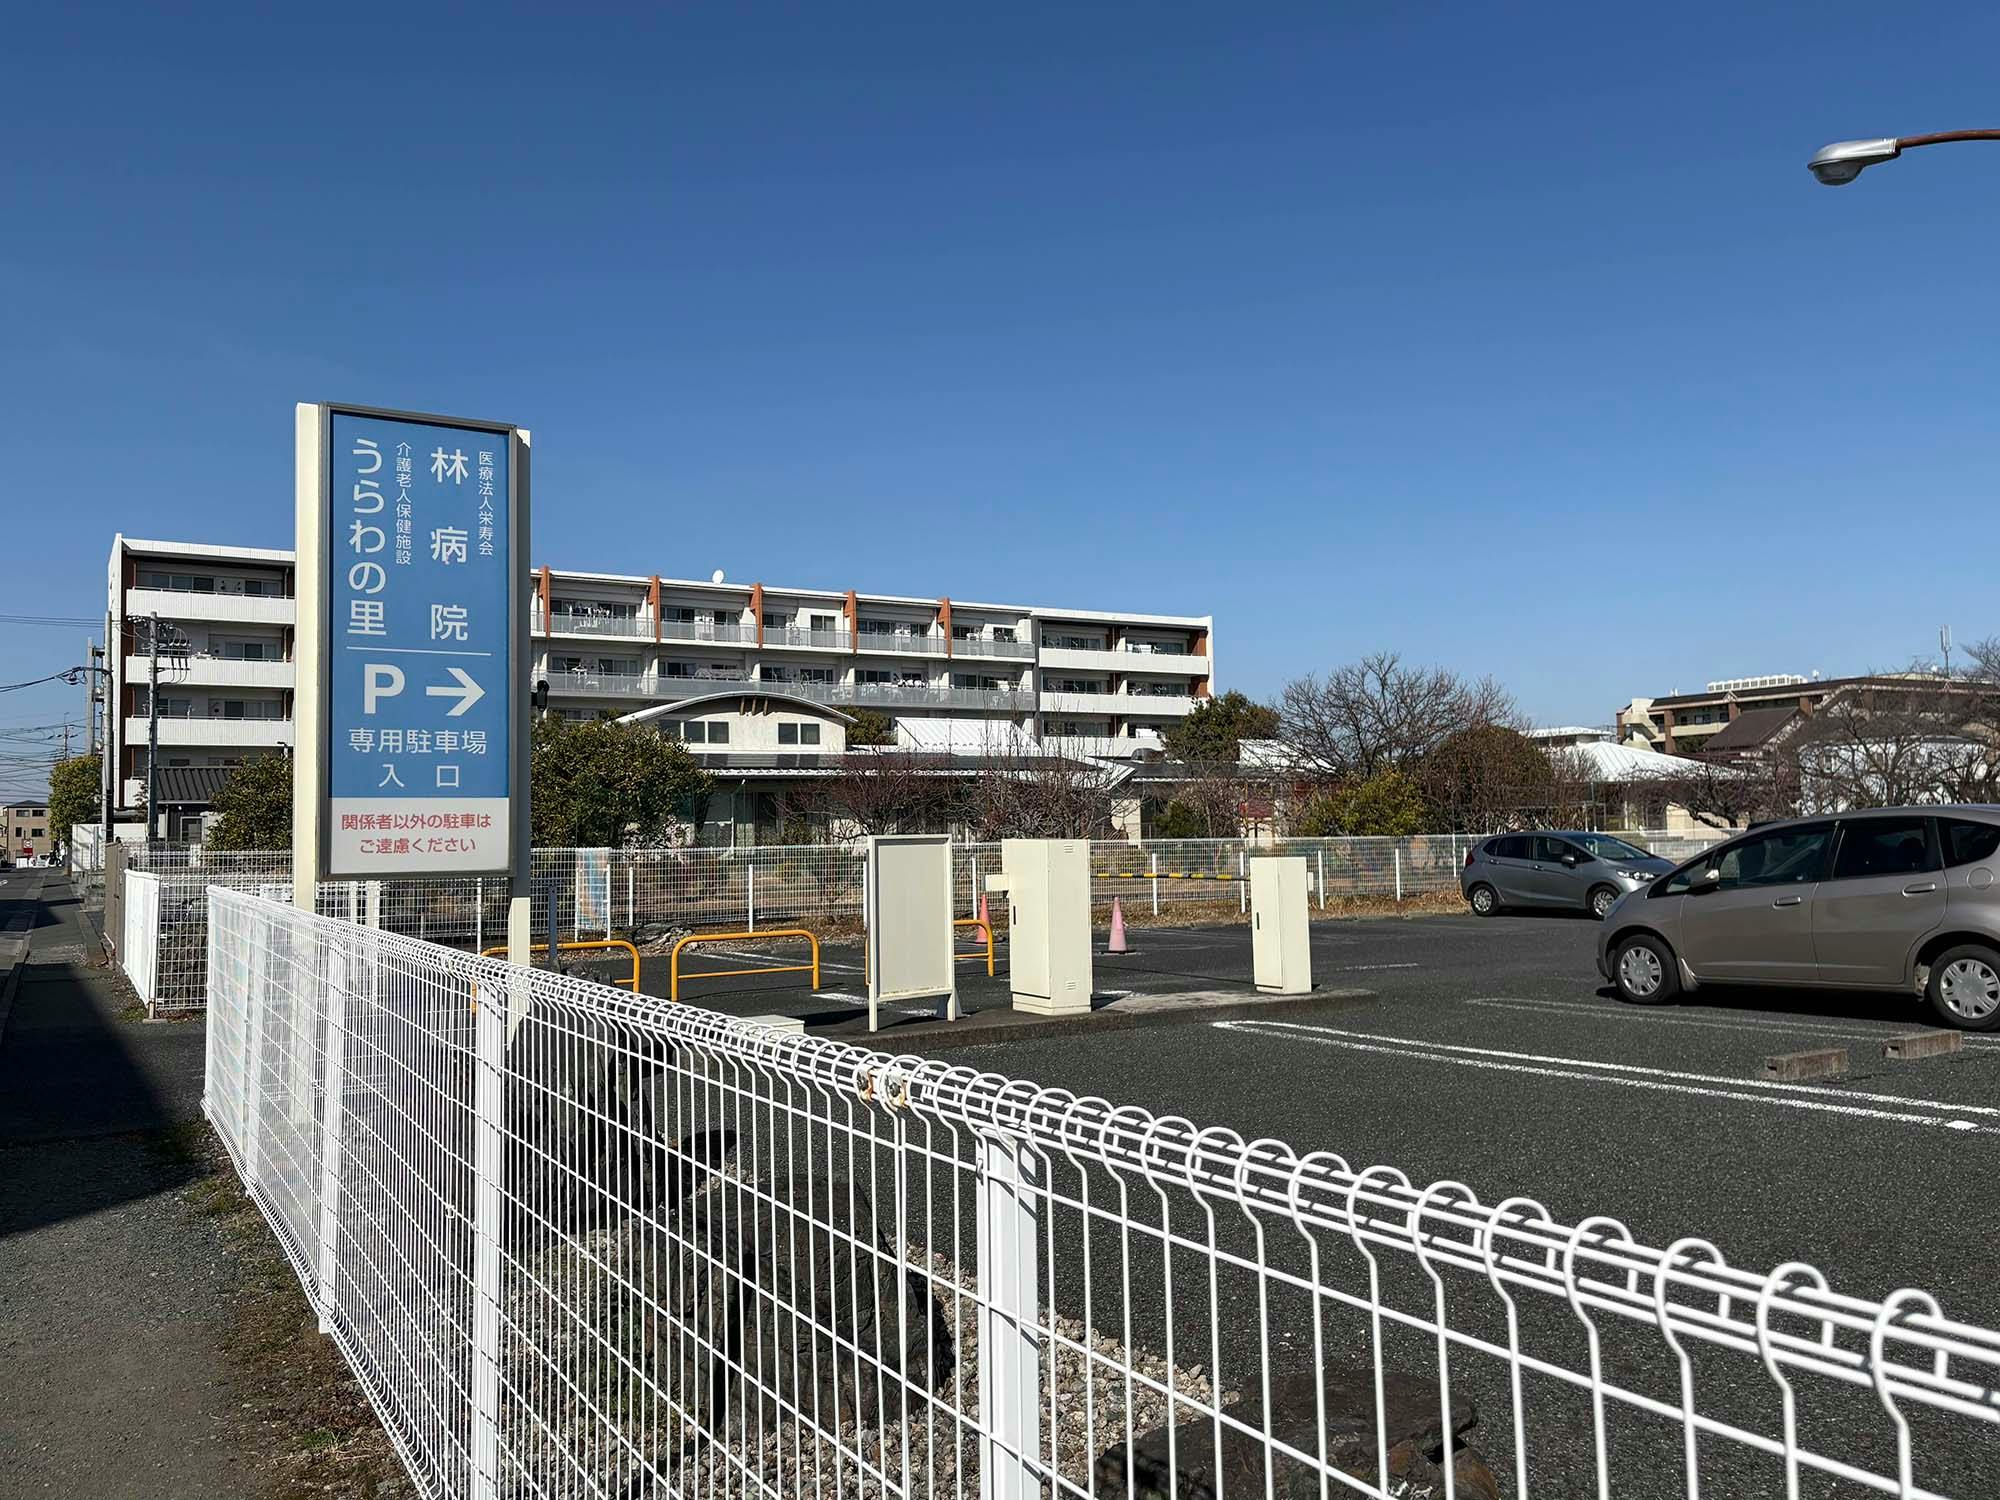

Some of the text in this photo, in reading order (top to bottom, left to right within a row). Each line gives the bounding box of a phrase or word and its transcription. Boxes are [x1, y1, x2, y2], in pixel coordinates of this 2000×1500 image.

[395, 441, 412, 566] 介護老人保健施設
[478, 451, 494, 556] 医療法人栄寿会
[347, 438, 387, 636] うらわの里
[363, 663, 406, 714] P
[348, 728, 487, 755] 専用駐車場
[341, 814, 492, 831] 関係者以外の駐車は
[360, 838, 476, 855] ご遠慮ください
